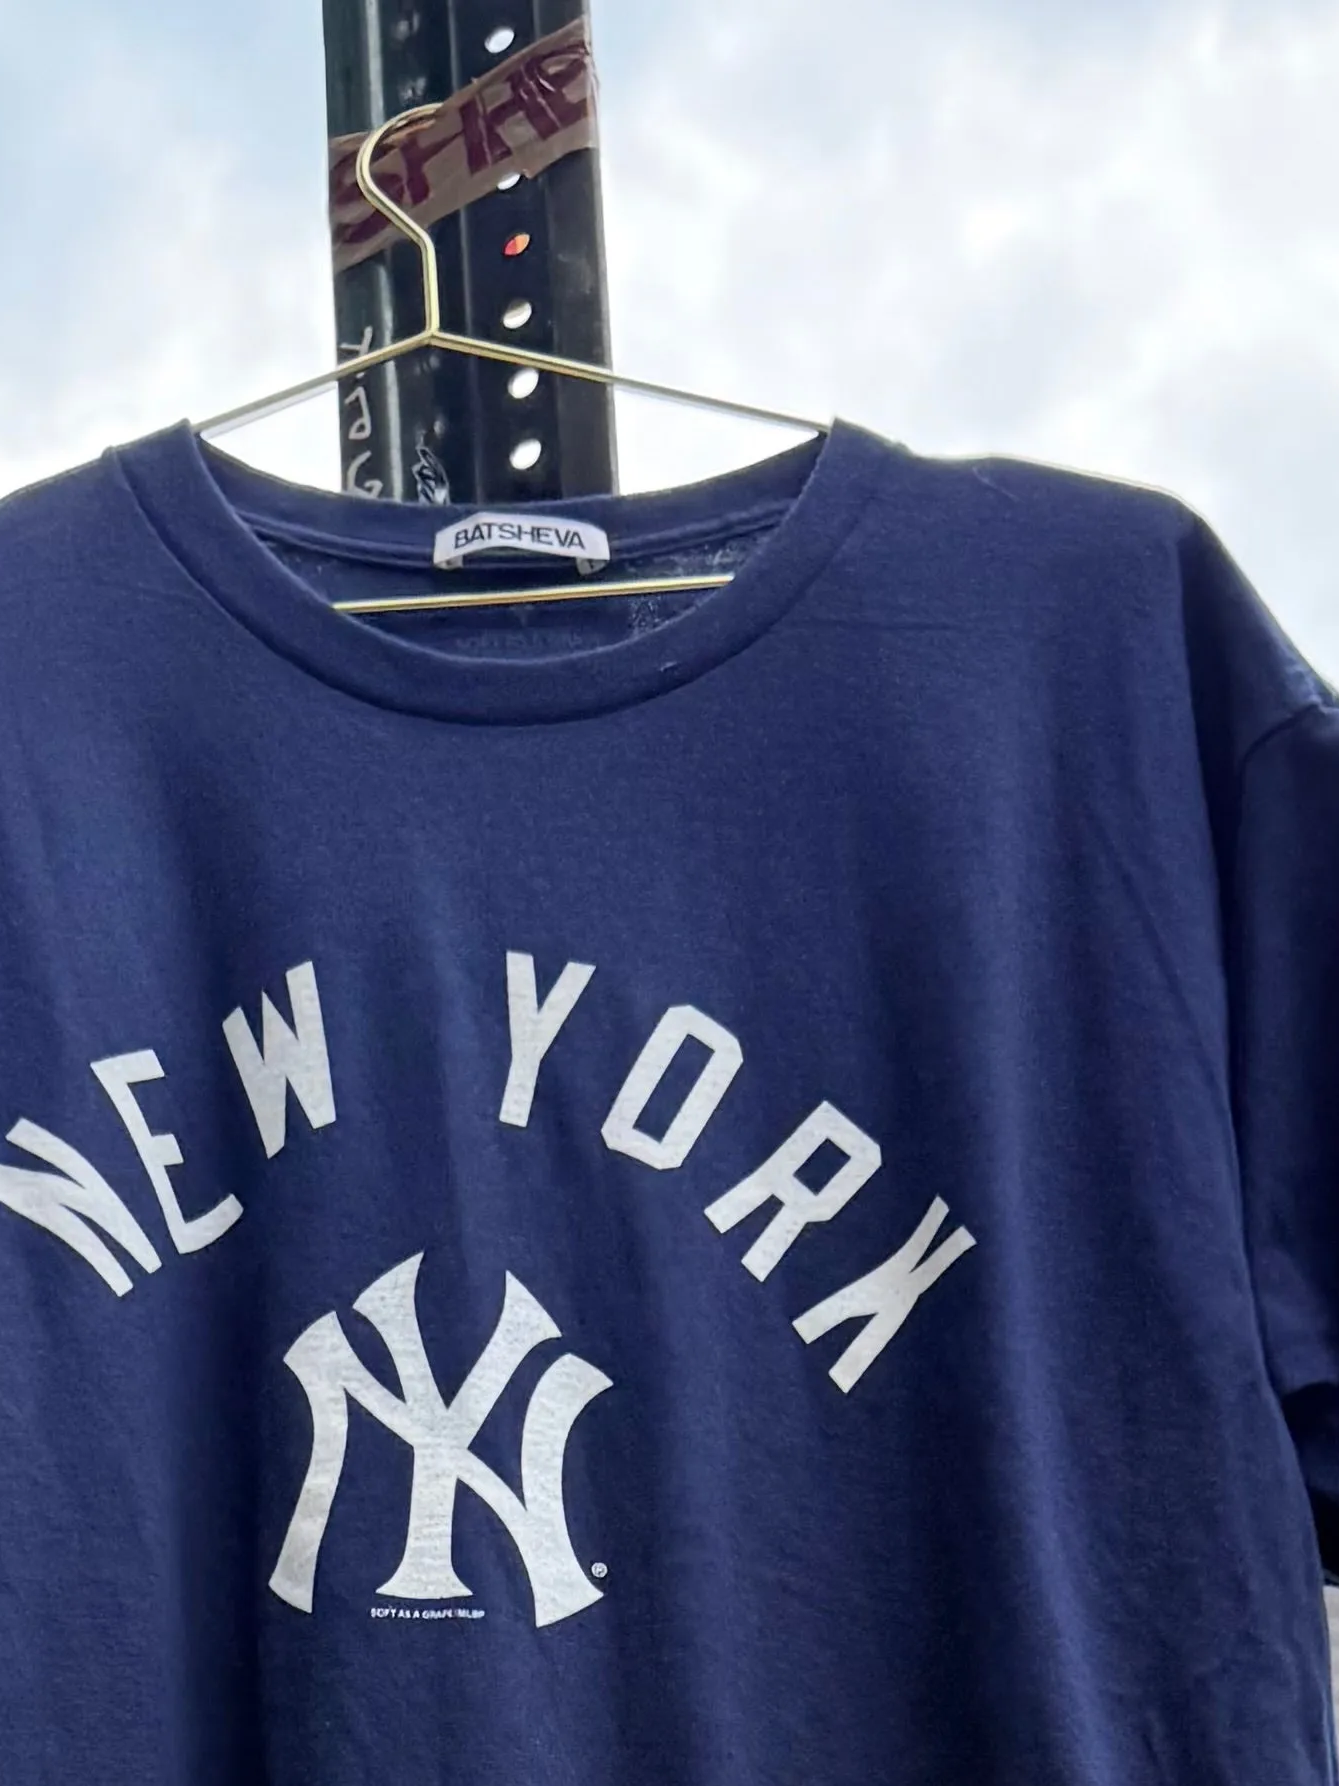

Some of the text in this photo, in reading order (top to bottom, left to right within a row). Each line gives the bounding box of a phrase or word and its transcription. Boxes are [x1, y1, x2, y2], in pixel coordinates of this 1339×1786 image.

[454, 522, 586, 550] BATSHEVA
[498, 949, 977, 1394] YORK
[412, 1609, 420, 1619] A
